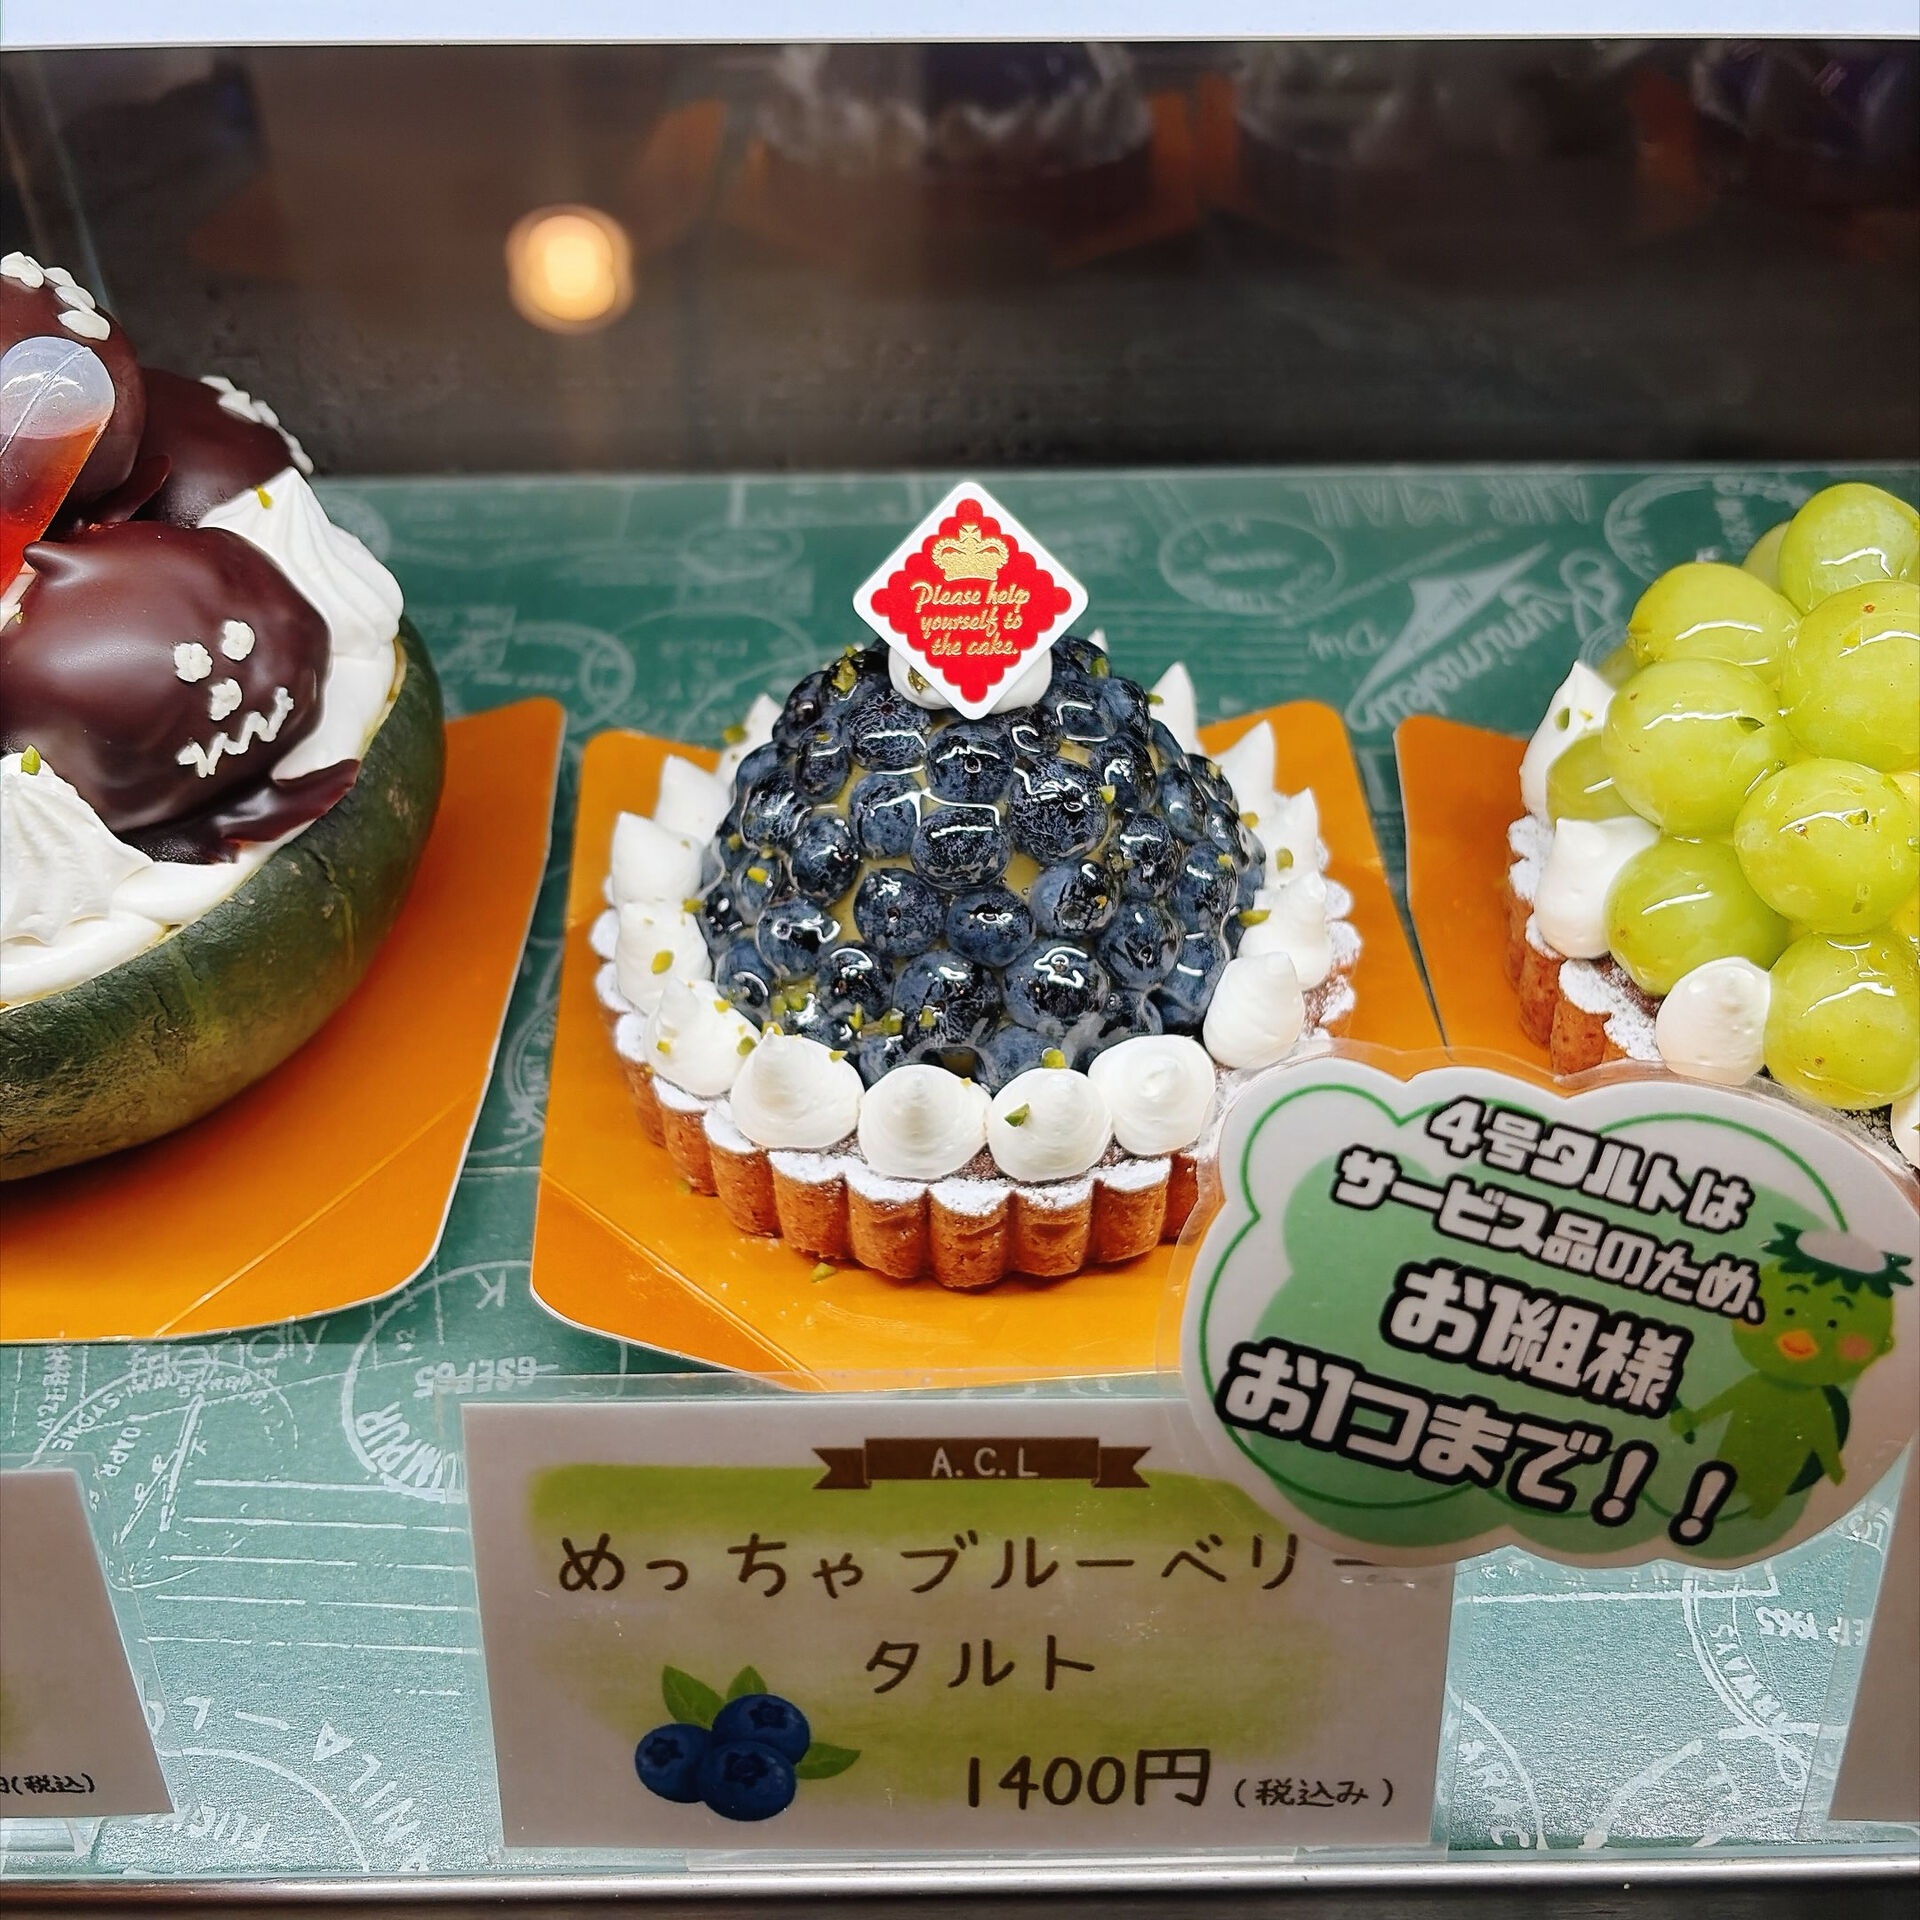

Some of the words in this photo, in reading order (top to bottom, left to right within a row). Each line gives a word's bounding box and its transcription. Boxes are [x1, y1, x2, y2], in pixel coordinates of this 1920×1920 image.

[910, 581, 982, 613] Please
[986, 581, 1031, 613] help
[920, 606, 998, 639] yourself
[1003, 613, 1023, 630] to
[931, 632, 962, 656] the
[967, 631, 1019, 656] cake.
[1425, 1095, 1755, 1233] 4号タルトは
[1332, 1144, 1766, 1325] サービス品のため、
[1381, 1260, 1693, 1419] お1組様
[930, 1447, 1038, 1478] A.C.L
[558, 1530, 1383, 1600] めっちゃブルーベリー
[865, 1635, 1095, 1694] タルト
[968, 1748, 1211, 1810] 1400円
